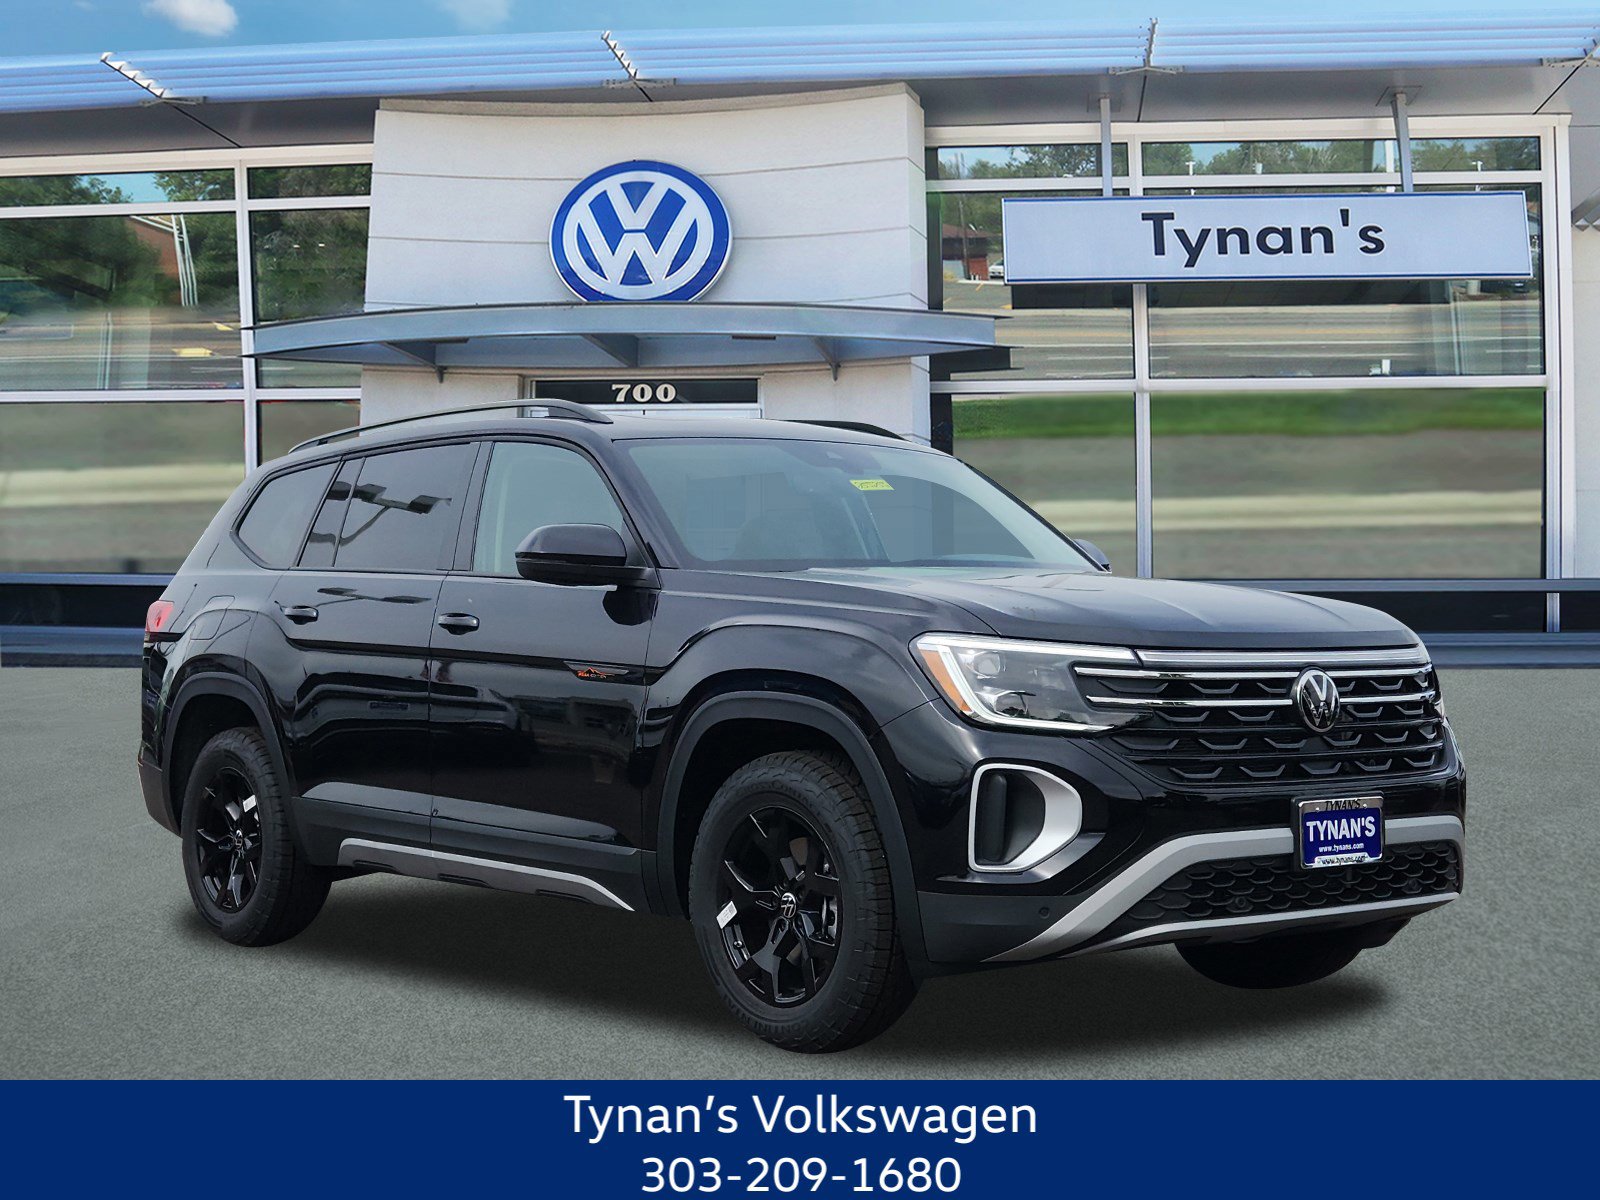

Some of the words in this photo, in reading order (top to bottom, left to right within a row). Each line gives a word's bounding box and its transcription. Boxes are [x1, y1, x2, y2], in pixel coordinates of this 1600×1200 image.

[1140, 208, 1386, 268] Tynan's
[611, 383, 677, 403] 700
[1325, 799, 1361, 811] TYNAN'S
[1306, 816, 1376, 842] TYNAN'S
[1318, 843, 1365, 853] www.tynans.com
